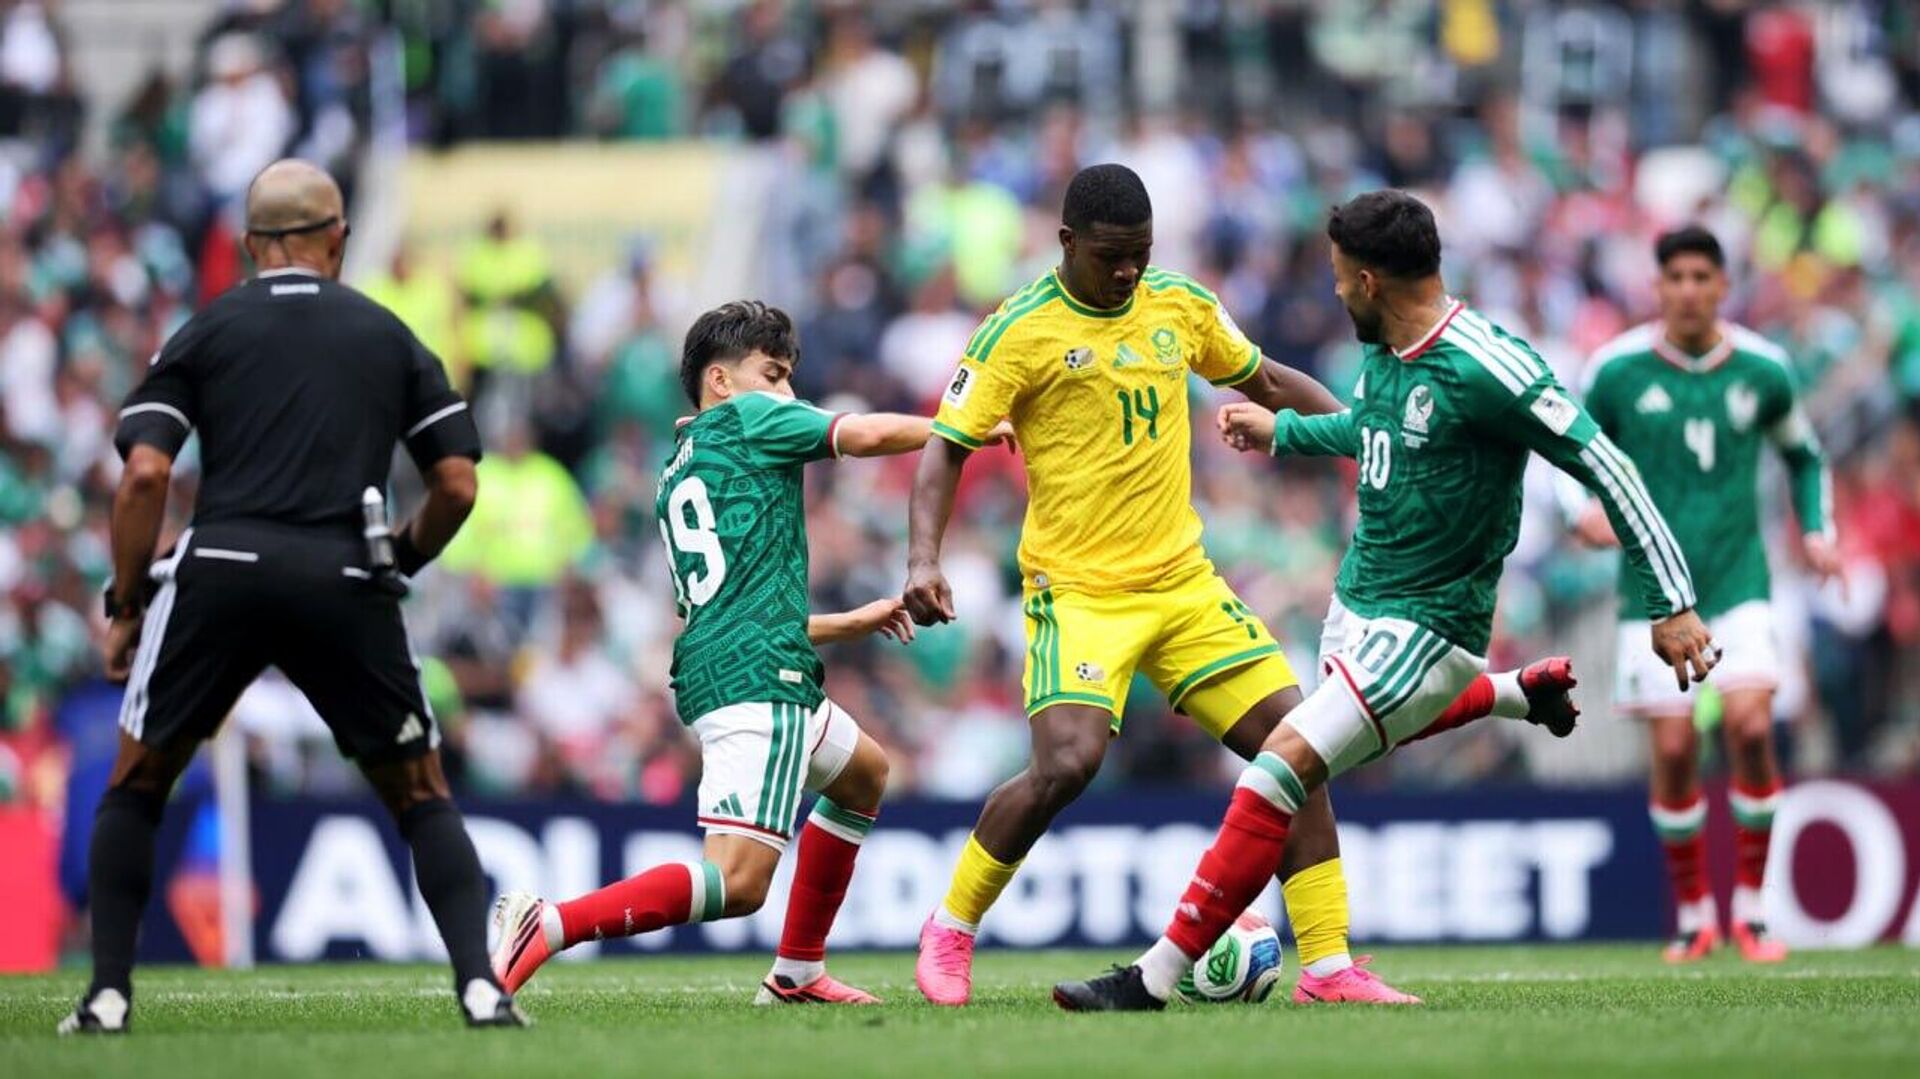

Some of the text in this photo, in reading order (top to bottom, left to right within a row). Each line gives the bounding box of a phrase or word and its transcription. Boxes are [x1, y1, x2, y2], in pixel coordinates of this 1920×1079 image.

[1118, 386, 1159, 445] 14
[1685, 417, 1715, 471] 4
[1361, 426, 1391, 490] 10
